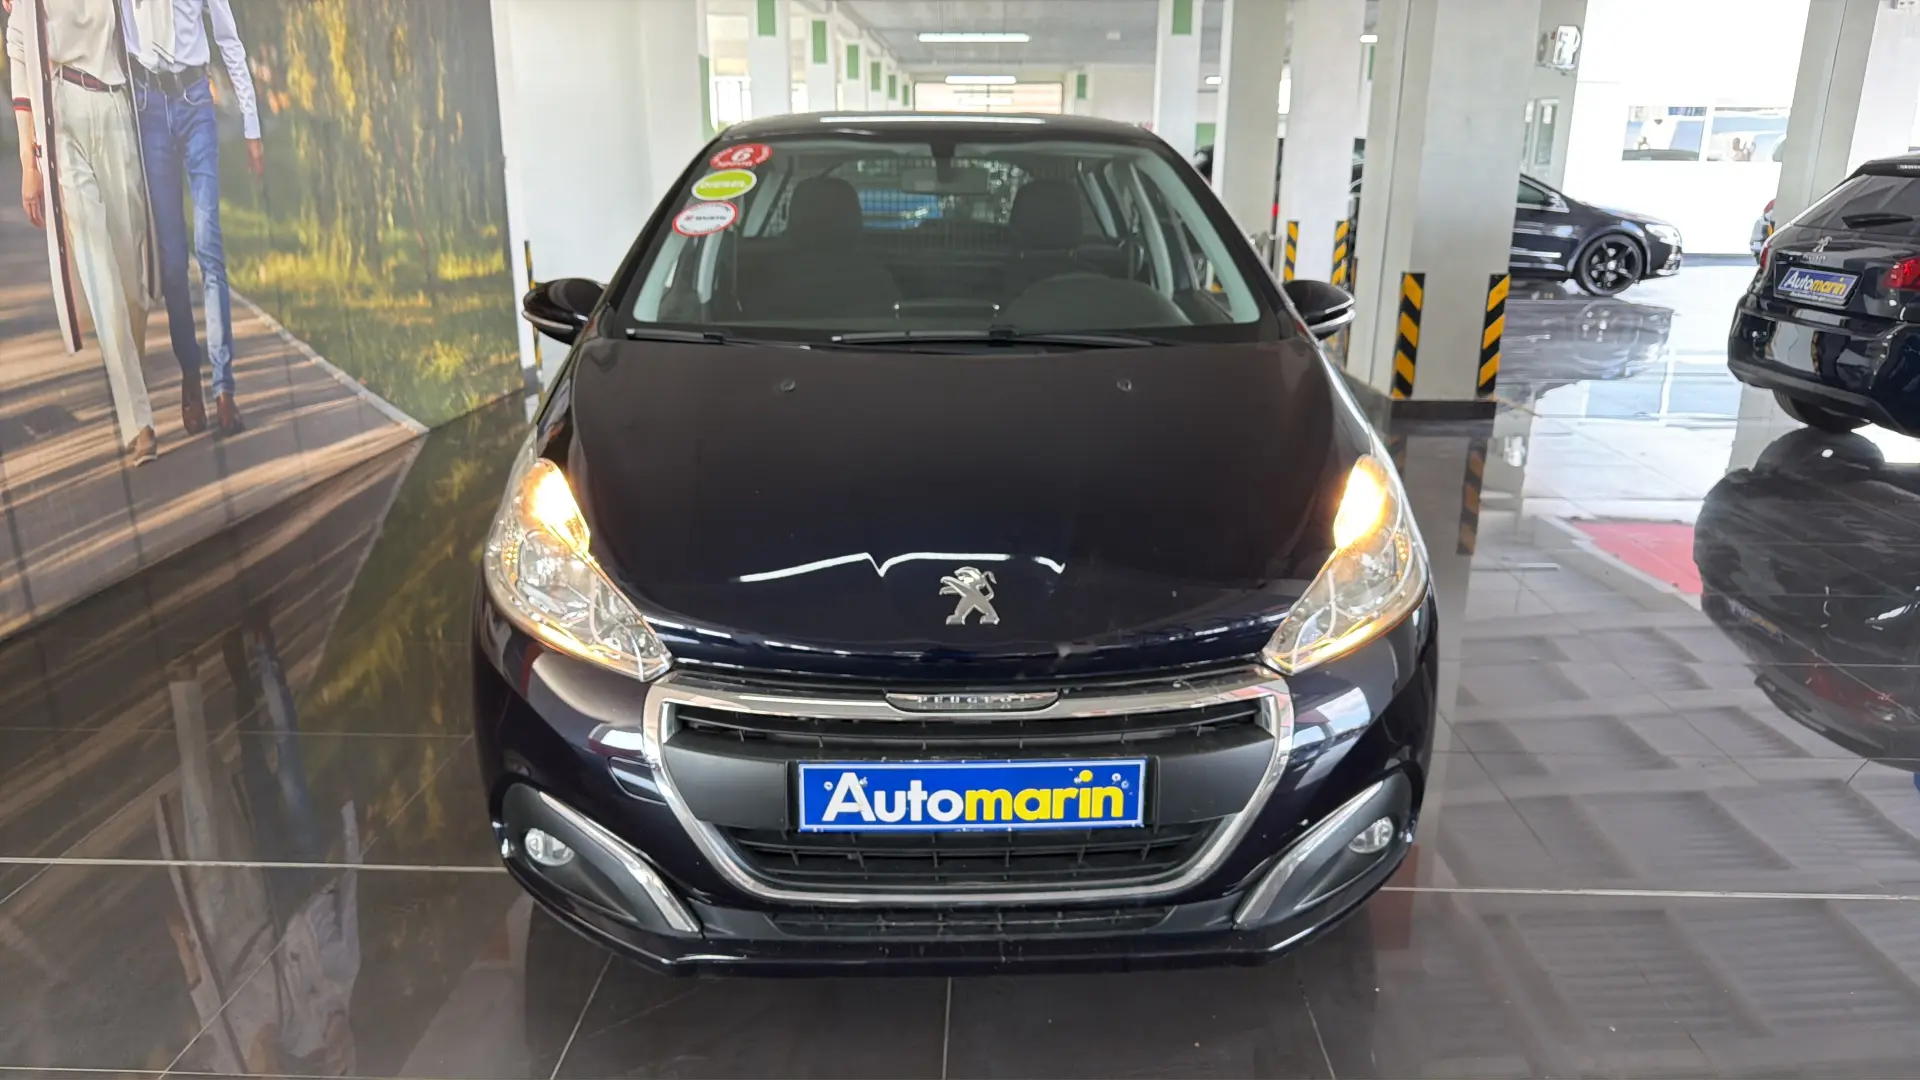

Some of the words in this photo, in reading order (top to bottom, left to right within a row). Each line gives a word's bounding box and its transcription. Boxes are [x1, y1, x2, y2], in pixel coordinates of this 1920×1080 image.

[731, 147, 755, 162] 6
[1783, 269, 1847, 296] Automarin
[821, 769, 1125, 823] Automarin
